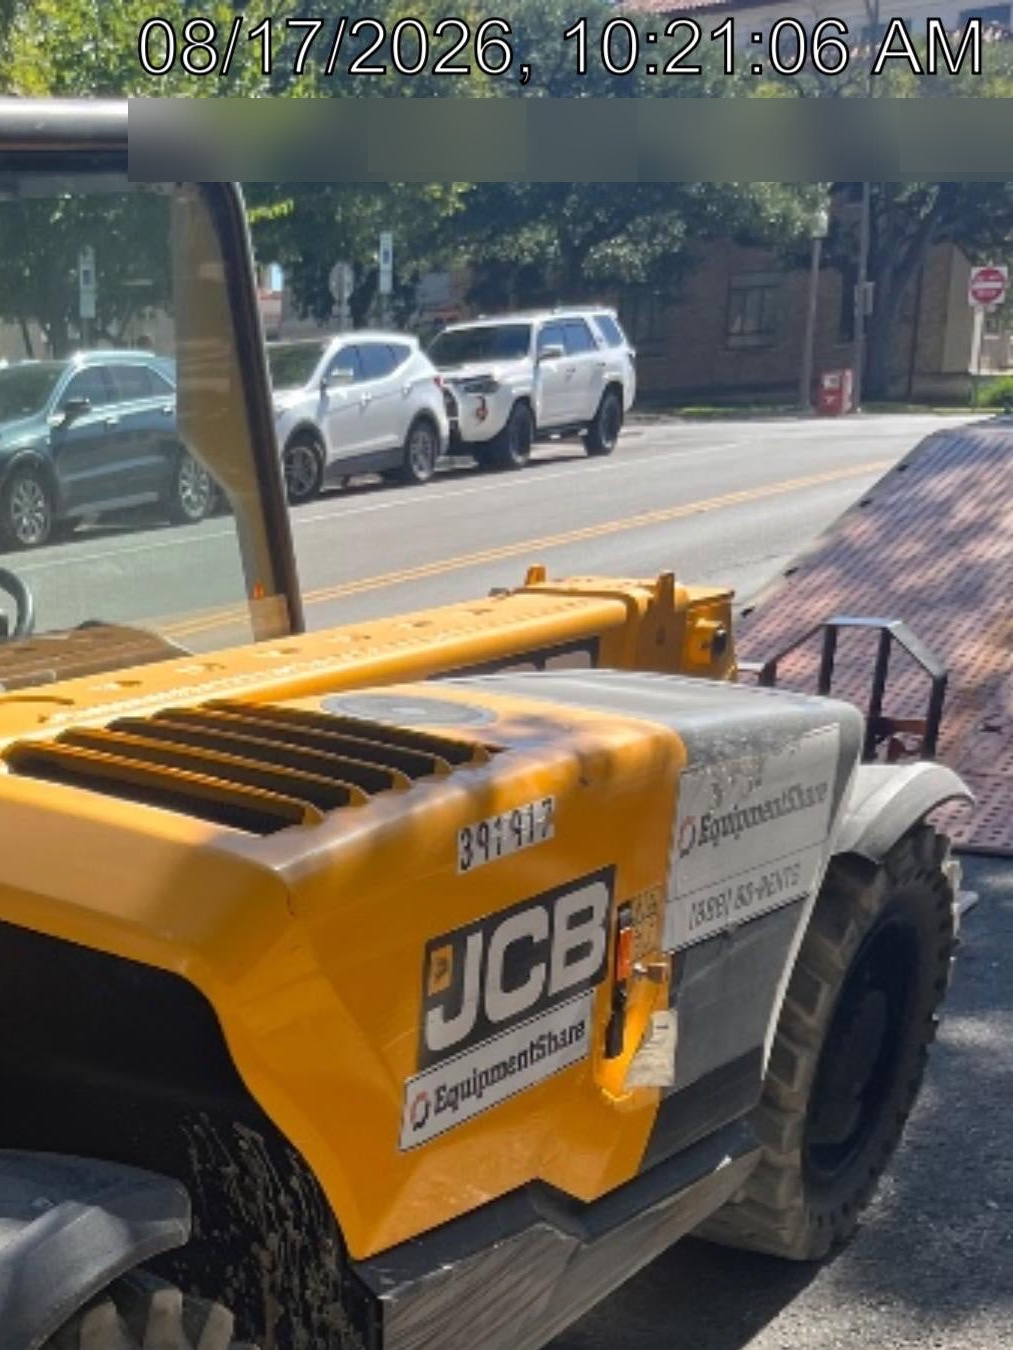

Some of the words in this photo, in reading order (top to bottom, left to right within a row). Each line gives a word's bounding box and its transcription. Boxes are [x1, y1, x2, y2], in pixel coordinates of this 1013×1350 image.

[459, 797, 553, 871] 391917
[698, 782, 830, 847] EquipmentShare
[424, 880, 609, 1052] JCB
[432, 1020, 586, 1117] EquipmentShare
